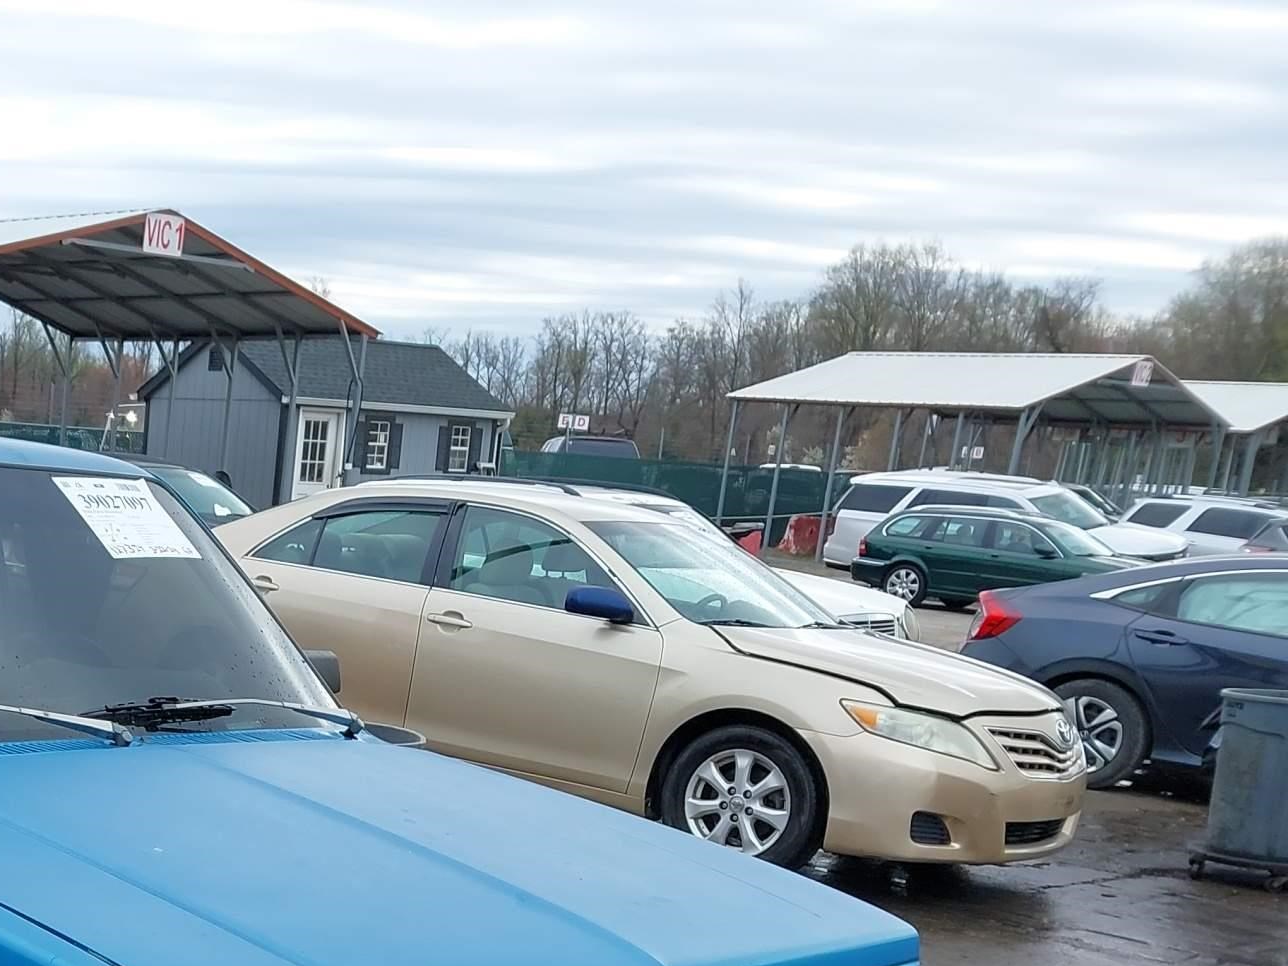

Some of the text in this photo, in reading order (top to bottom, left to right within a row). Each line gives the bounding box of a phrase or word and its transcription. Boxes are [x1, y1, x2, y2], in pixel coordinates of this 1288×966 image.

[147, 217, 184, 252] VIC 1
[577, 417, 586, 427] D
[77, 493, 153, 512] 39027097
